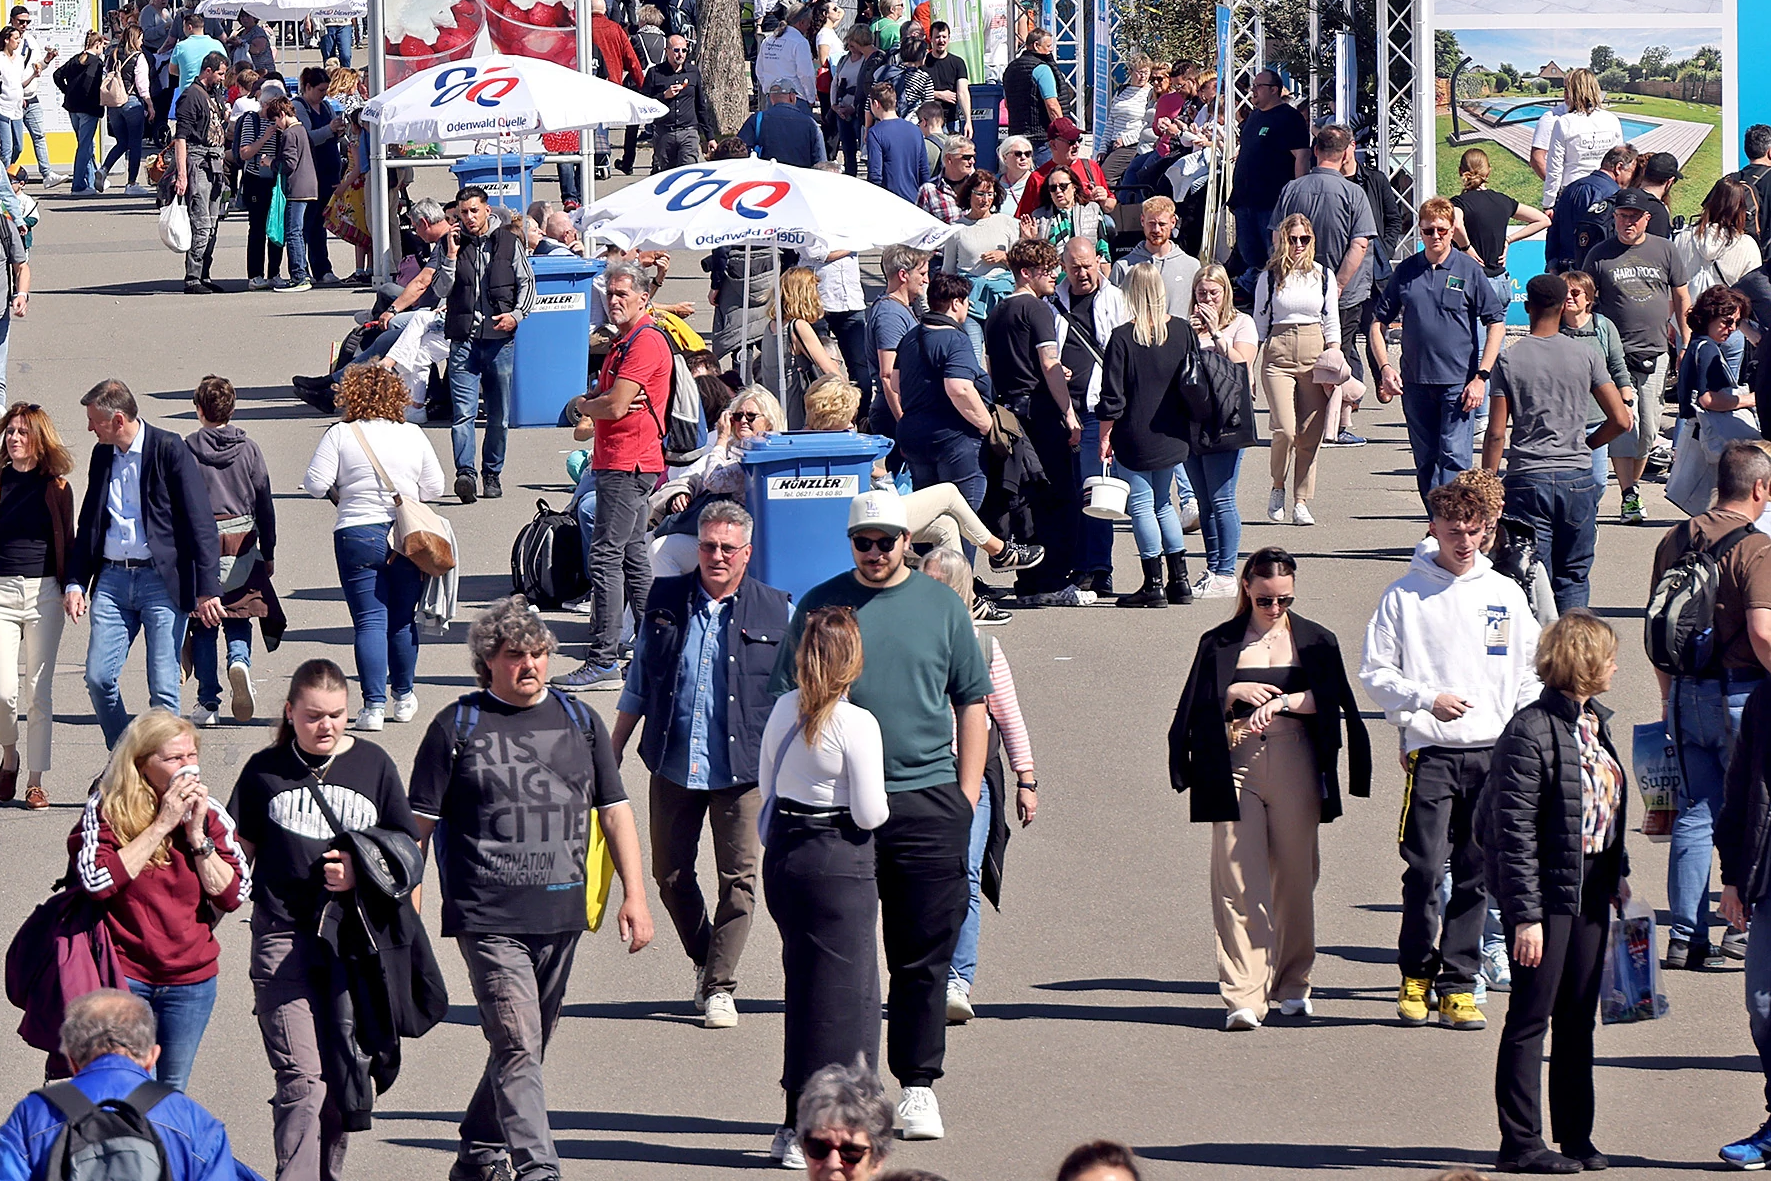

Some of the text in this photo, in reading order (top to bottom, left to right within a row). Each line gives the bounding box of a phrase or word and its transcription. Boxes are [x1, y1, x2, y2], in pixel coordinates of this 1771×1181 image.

[446, 116, 527, 133] Odenwald Quelle
[695, 228, 761, 246] Odenwald
[1637, 265, 1662, 280] ROCK
[778, 476, 845, 490] KÜNZLER
[783, 490, 795, 498] Tel.
